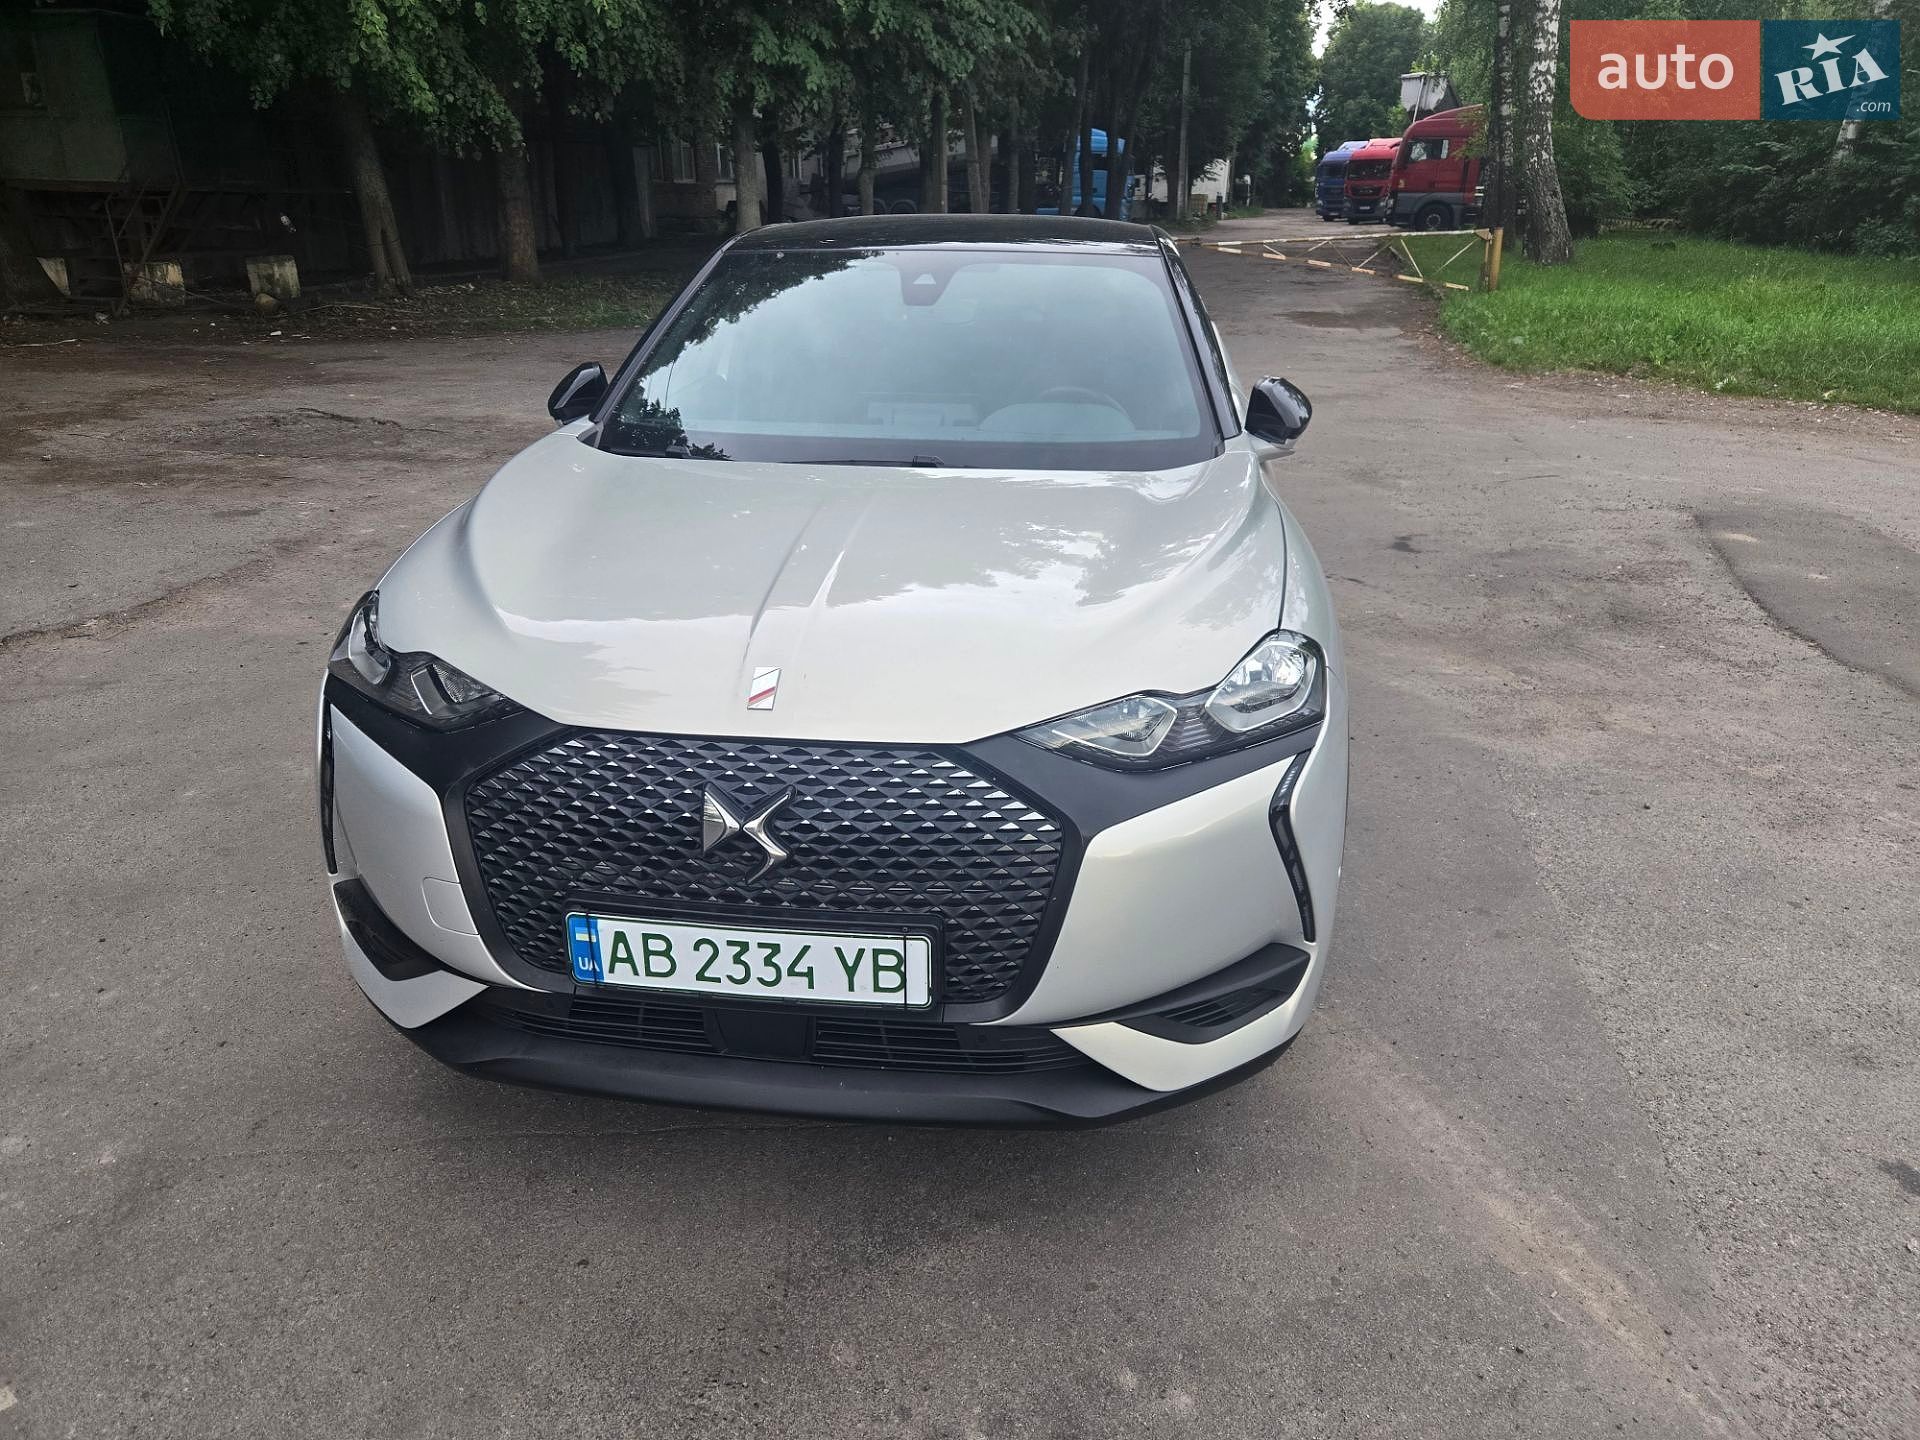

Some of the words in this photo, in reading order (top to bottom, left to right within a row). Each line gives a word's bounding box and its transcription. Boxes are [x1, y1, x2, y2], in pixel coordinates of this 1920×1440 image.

[578, 956, 600, 972] UA
[608, 930, 677, 978] AB
[693, 937, 815, 990] 2334
[833, 945, 906, 993] YB
